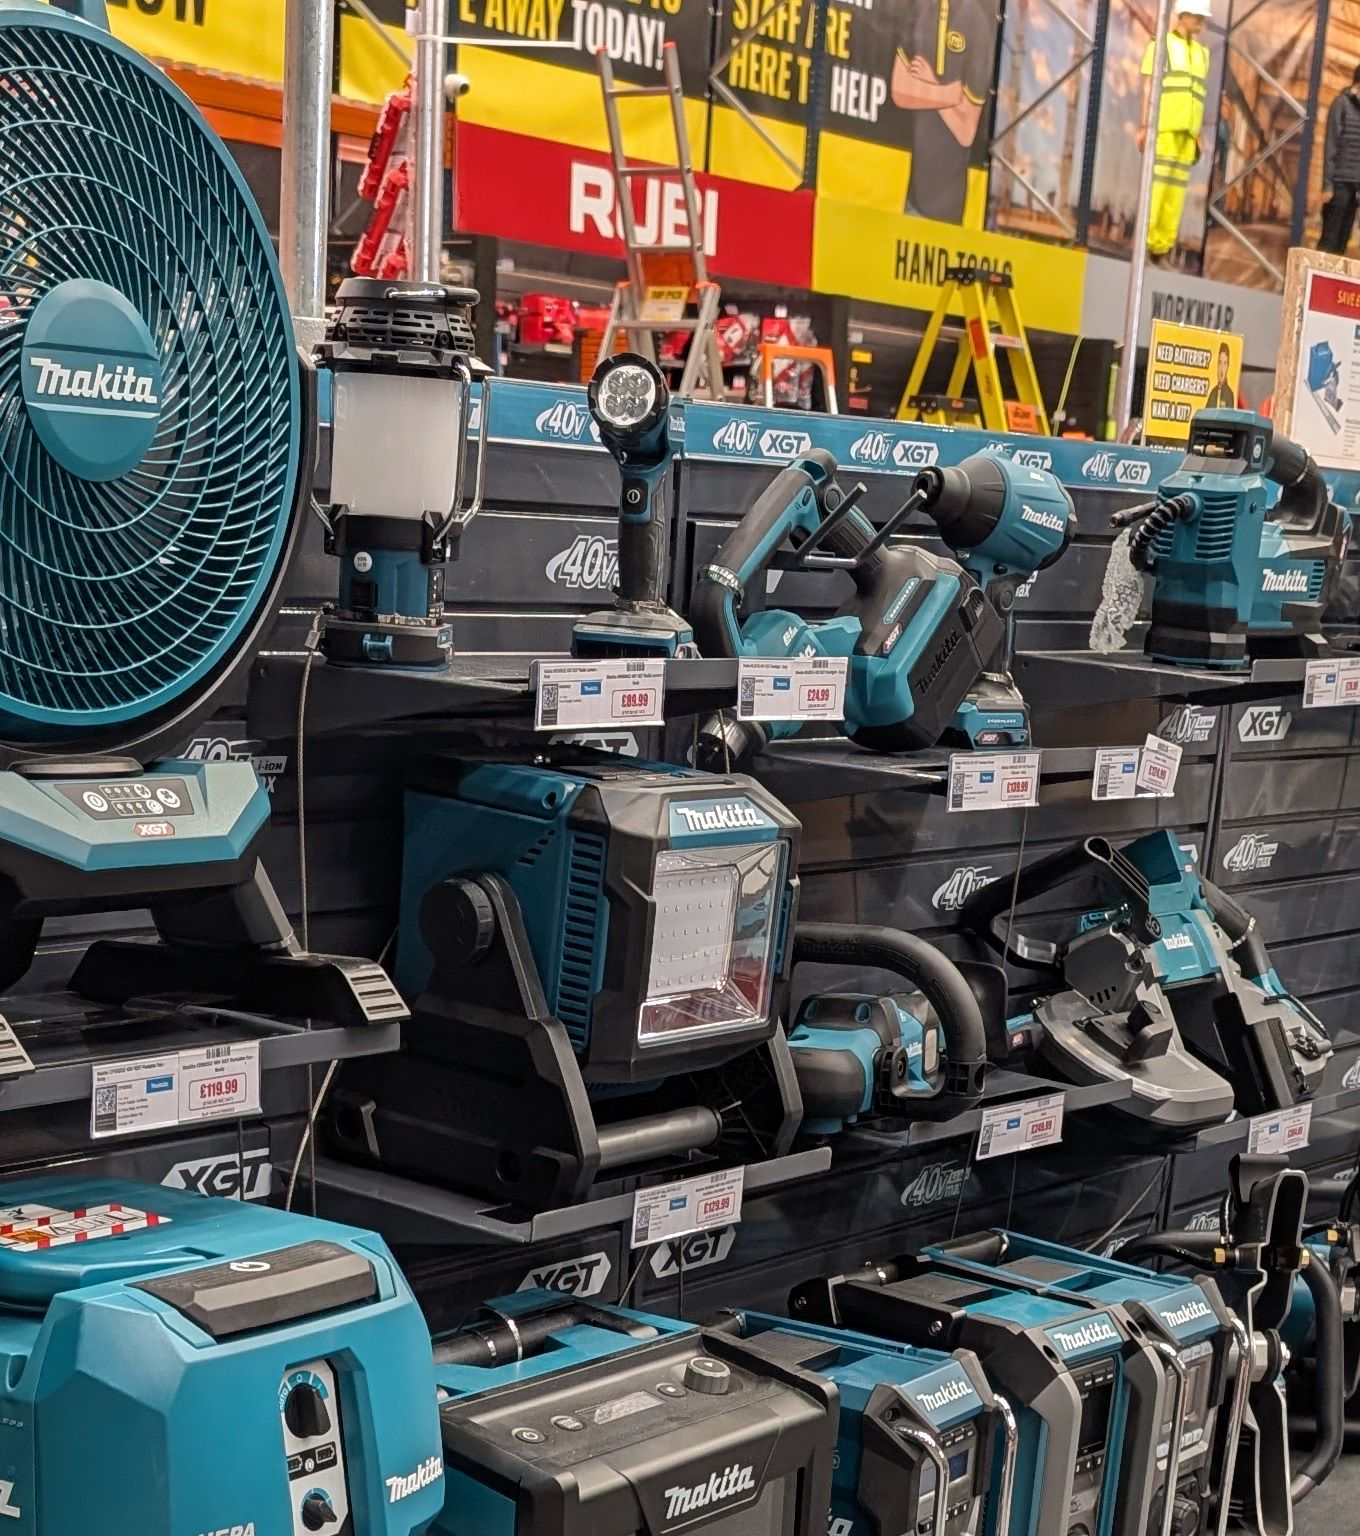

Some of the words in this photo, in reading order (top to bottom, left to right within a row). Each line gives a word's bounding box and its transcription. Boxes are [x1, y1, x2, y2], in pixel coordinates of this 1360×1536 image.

[572, 0, 665, 70] TODAY!
[729, 38, 794, 100] HERE
[830, 65, 887, 122] HELP
[895, 239, 948, 287] HAND
[1156, 344, 1174, 363] NEED
[1175, 347, 1211, 368] BATTERIES?
[30, 358, 158, 404] Makita
[1154, 373, 1171, 391] NEED
[1172, 376, 1210, 397] CHARGERS?
[1151, 401, 1169, 419] WANT
[764, 433, 808, 455] XGT
[898, 444, 935, 466] XGT
[1120, 461, 1149, 482] XGT
[1021, 504, 1065, 532] Makita
[1261, 568, 1308, 592] Makita
[1247, 712, 1287, 738] XGT
[135, 823, 173, 837] XGT
[675, 801, 765, 832] Makita
[199, 1079, 239, 1099] £119.99
[180, 1154, 270, 1199] XGT
[1160, 1301, 1212, 1327] Makita
[1054, 1321, 1117, 1352] Makita
[916, 1378, 973, 1412] Makita
[385, 1456, 443, 1504] Makita
[665, 1464, 756, 1520] Makita
